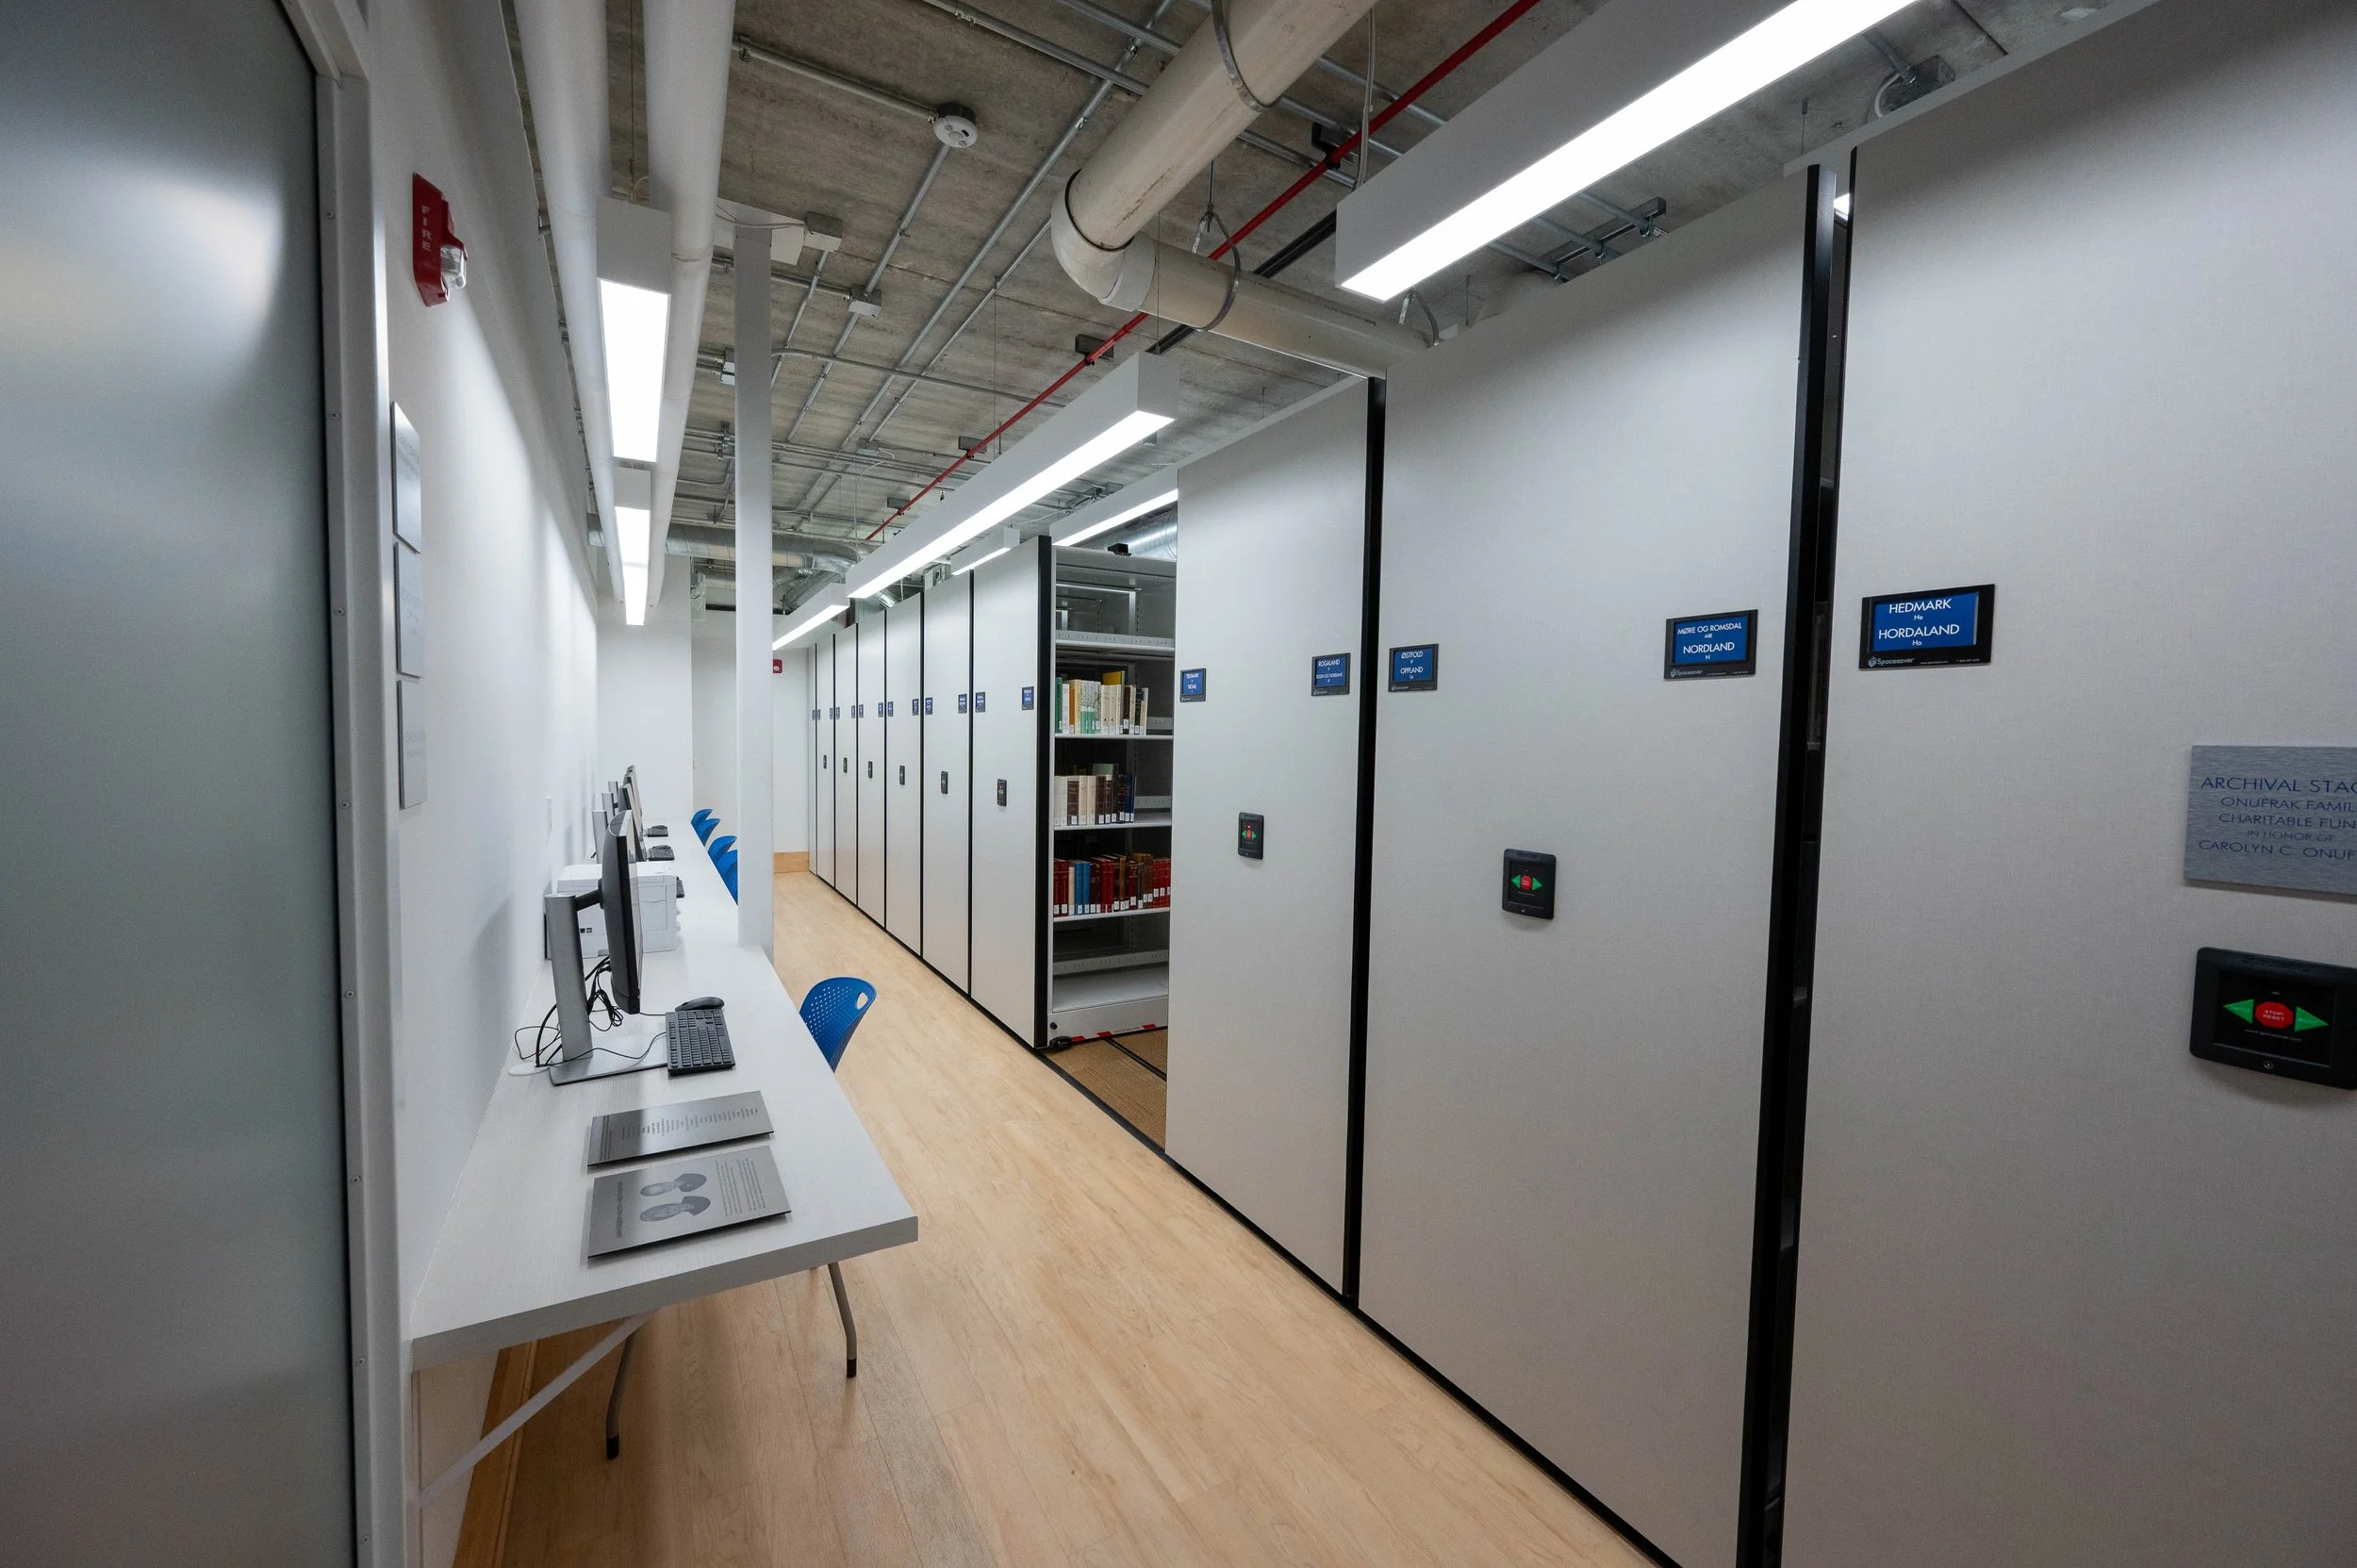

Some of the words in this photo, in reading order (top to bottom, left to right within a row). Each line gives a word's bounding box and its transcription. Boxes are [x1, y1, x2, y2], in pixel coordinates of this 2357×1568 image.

[421, 204, 432, 253] FIRE
[1888, 598, 1953, 614] HEDMARK
[1697, 625, 1708, 634] OG
[1709, 622, 1742, 632] ROMSDAL
[1878, 624, 1960, 639] HORDALAND
[1683, 641, 1736, 654] NORDLAND
[1876, 657, 1915, 667] Spacesaver
[2200, 776, 2302, 793] ARCHIVAL
[2220, 797, 2300, 810] ONUFRAK
[2218, 813, 2314, 828] CHARITABLE
[2264, 831, 2313, 841] HONOR
[2316, 834, 2334, 843] OF
[2199, 839, 2273, 854] CAROLYN
[2279, 846, 2296, 856] C.
[2263, 1014, 2285, 1022] RESET
